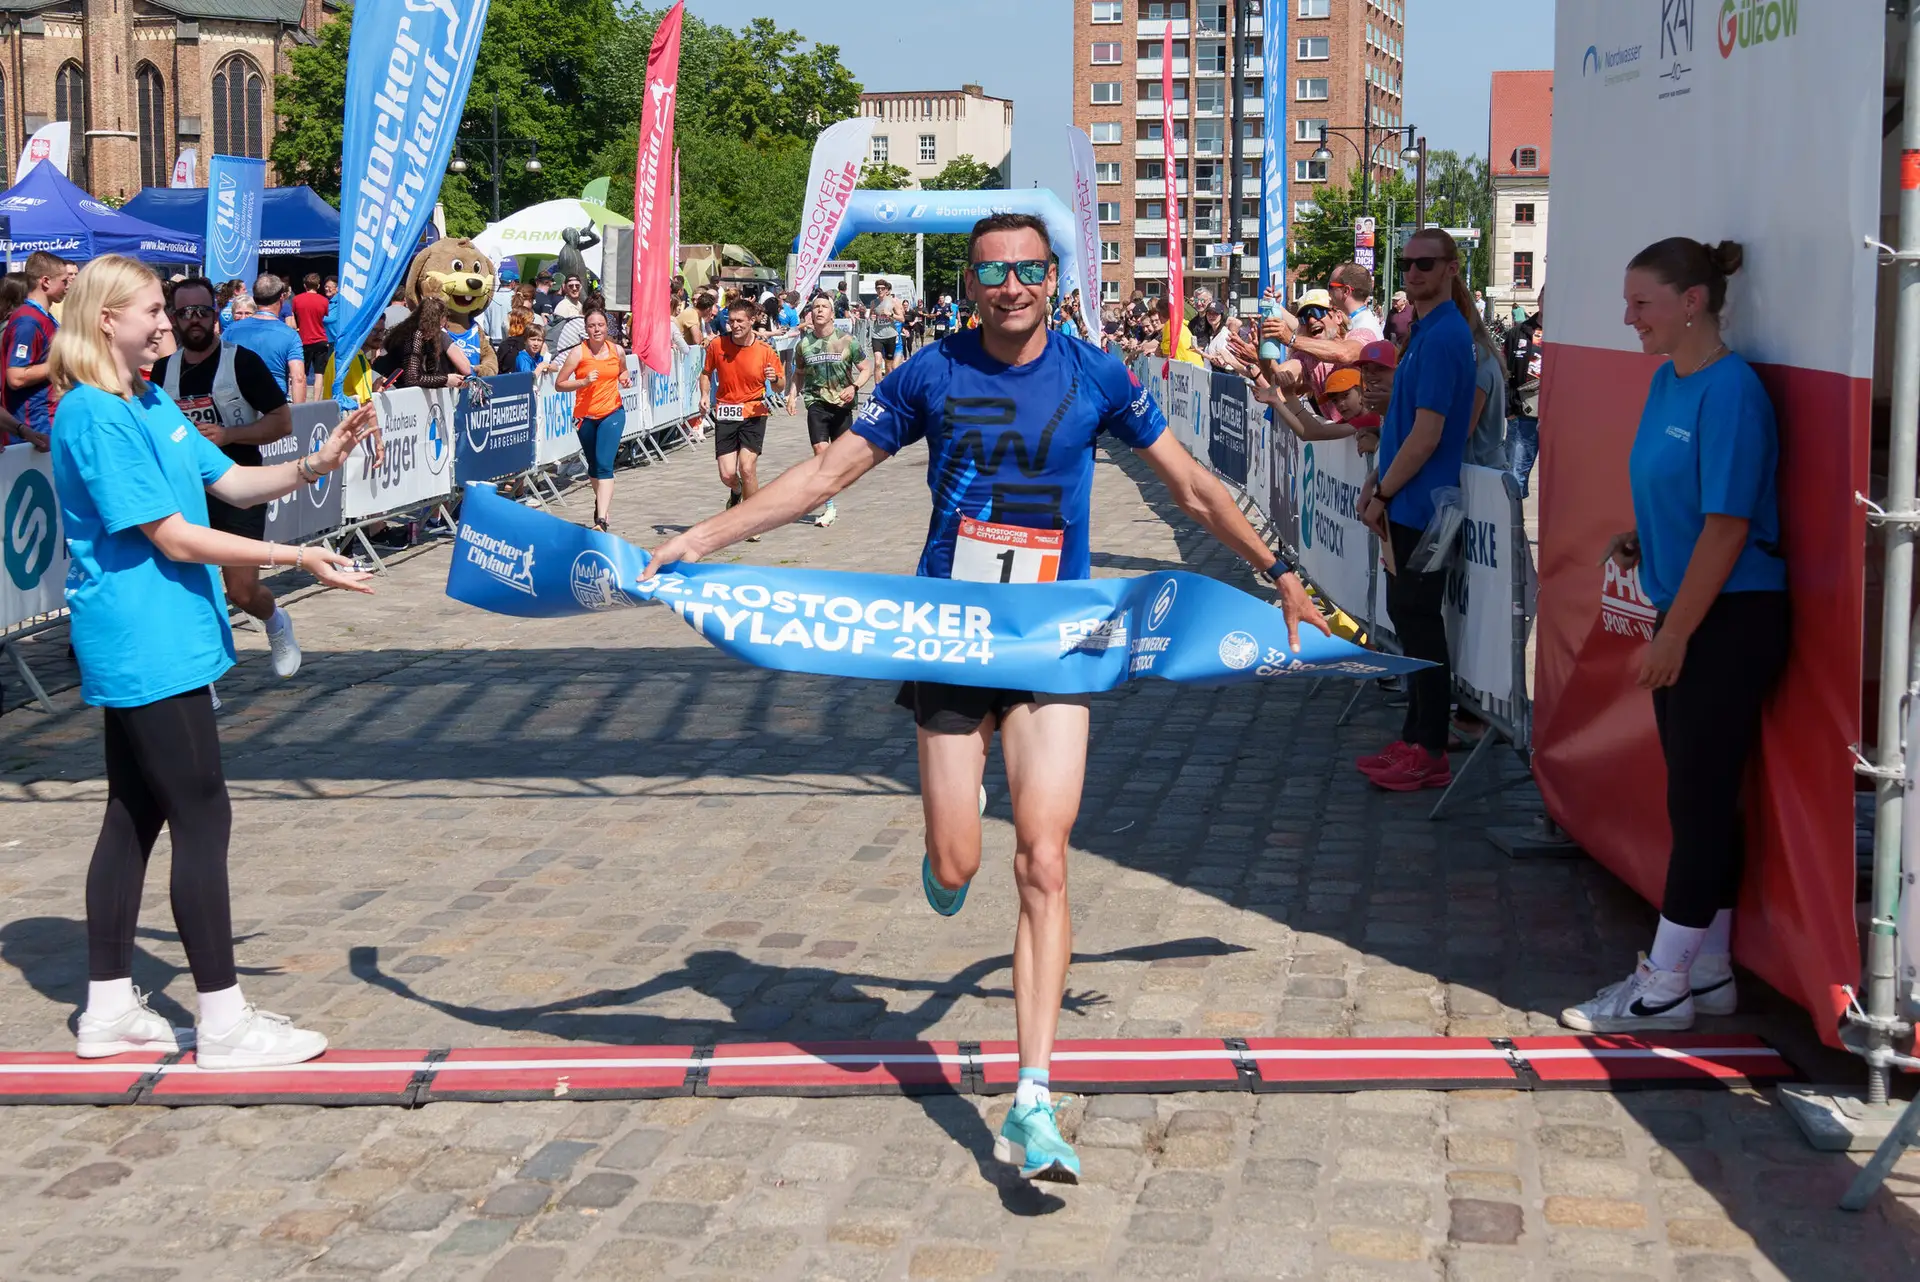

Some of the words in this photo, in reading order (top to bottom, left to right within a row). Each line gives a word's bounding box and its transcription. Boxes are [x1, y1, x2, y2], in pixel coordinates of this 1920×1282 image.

[339, 15, 421, 310] Rostocker
[501, 228, 563, 241] BARM
[385, 413, 417, 434] Autohaus
[470, 410, 490, 430] NUTZ
[492, 403, 528, 426] FAHRZEUGE
[718, 406, 743, 417] 1958
[460, 524, 524, 561] Rostocker
[976, 531, 1011, 541] CITYLAUF
[986, 526, 1028, 538] ROSTOCKER
[1315, 509, 1345, 559] ROSTOCK
[467, 545, 516, 578] Citylauf
[996, 549, 1015, 583] 1
[702, 582, 995, 640] ROSTOCKER
[1602, 611, 1634, 637] SPORT
[674, 599, 877, 655] ITYLAUF
[891, 636, 995, 665] 2024
[1263, 646, 1286, 668] 32.
